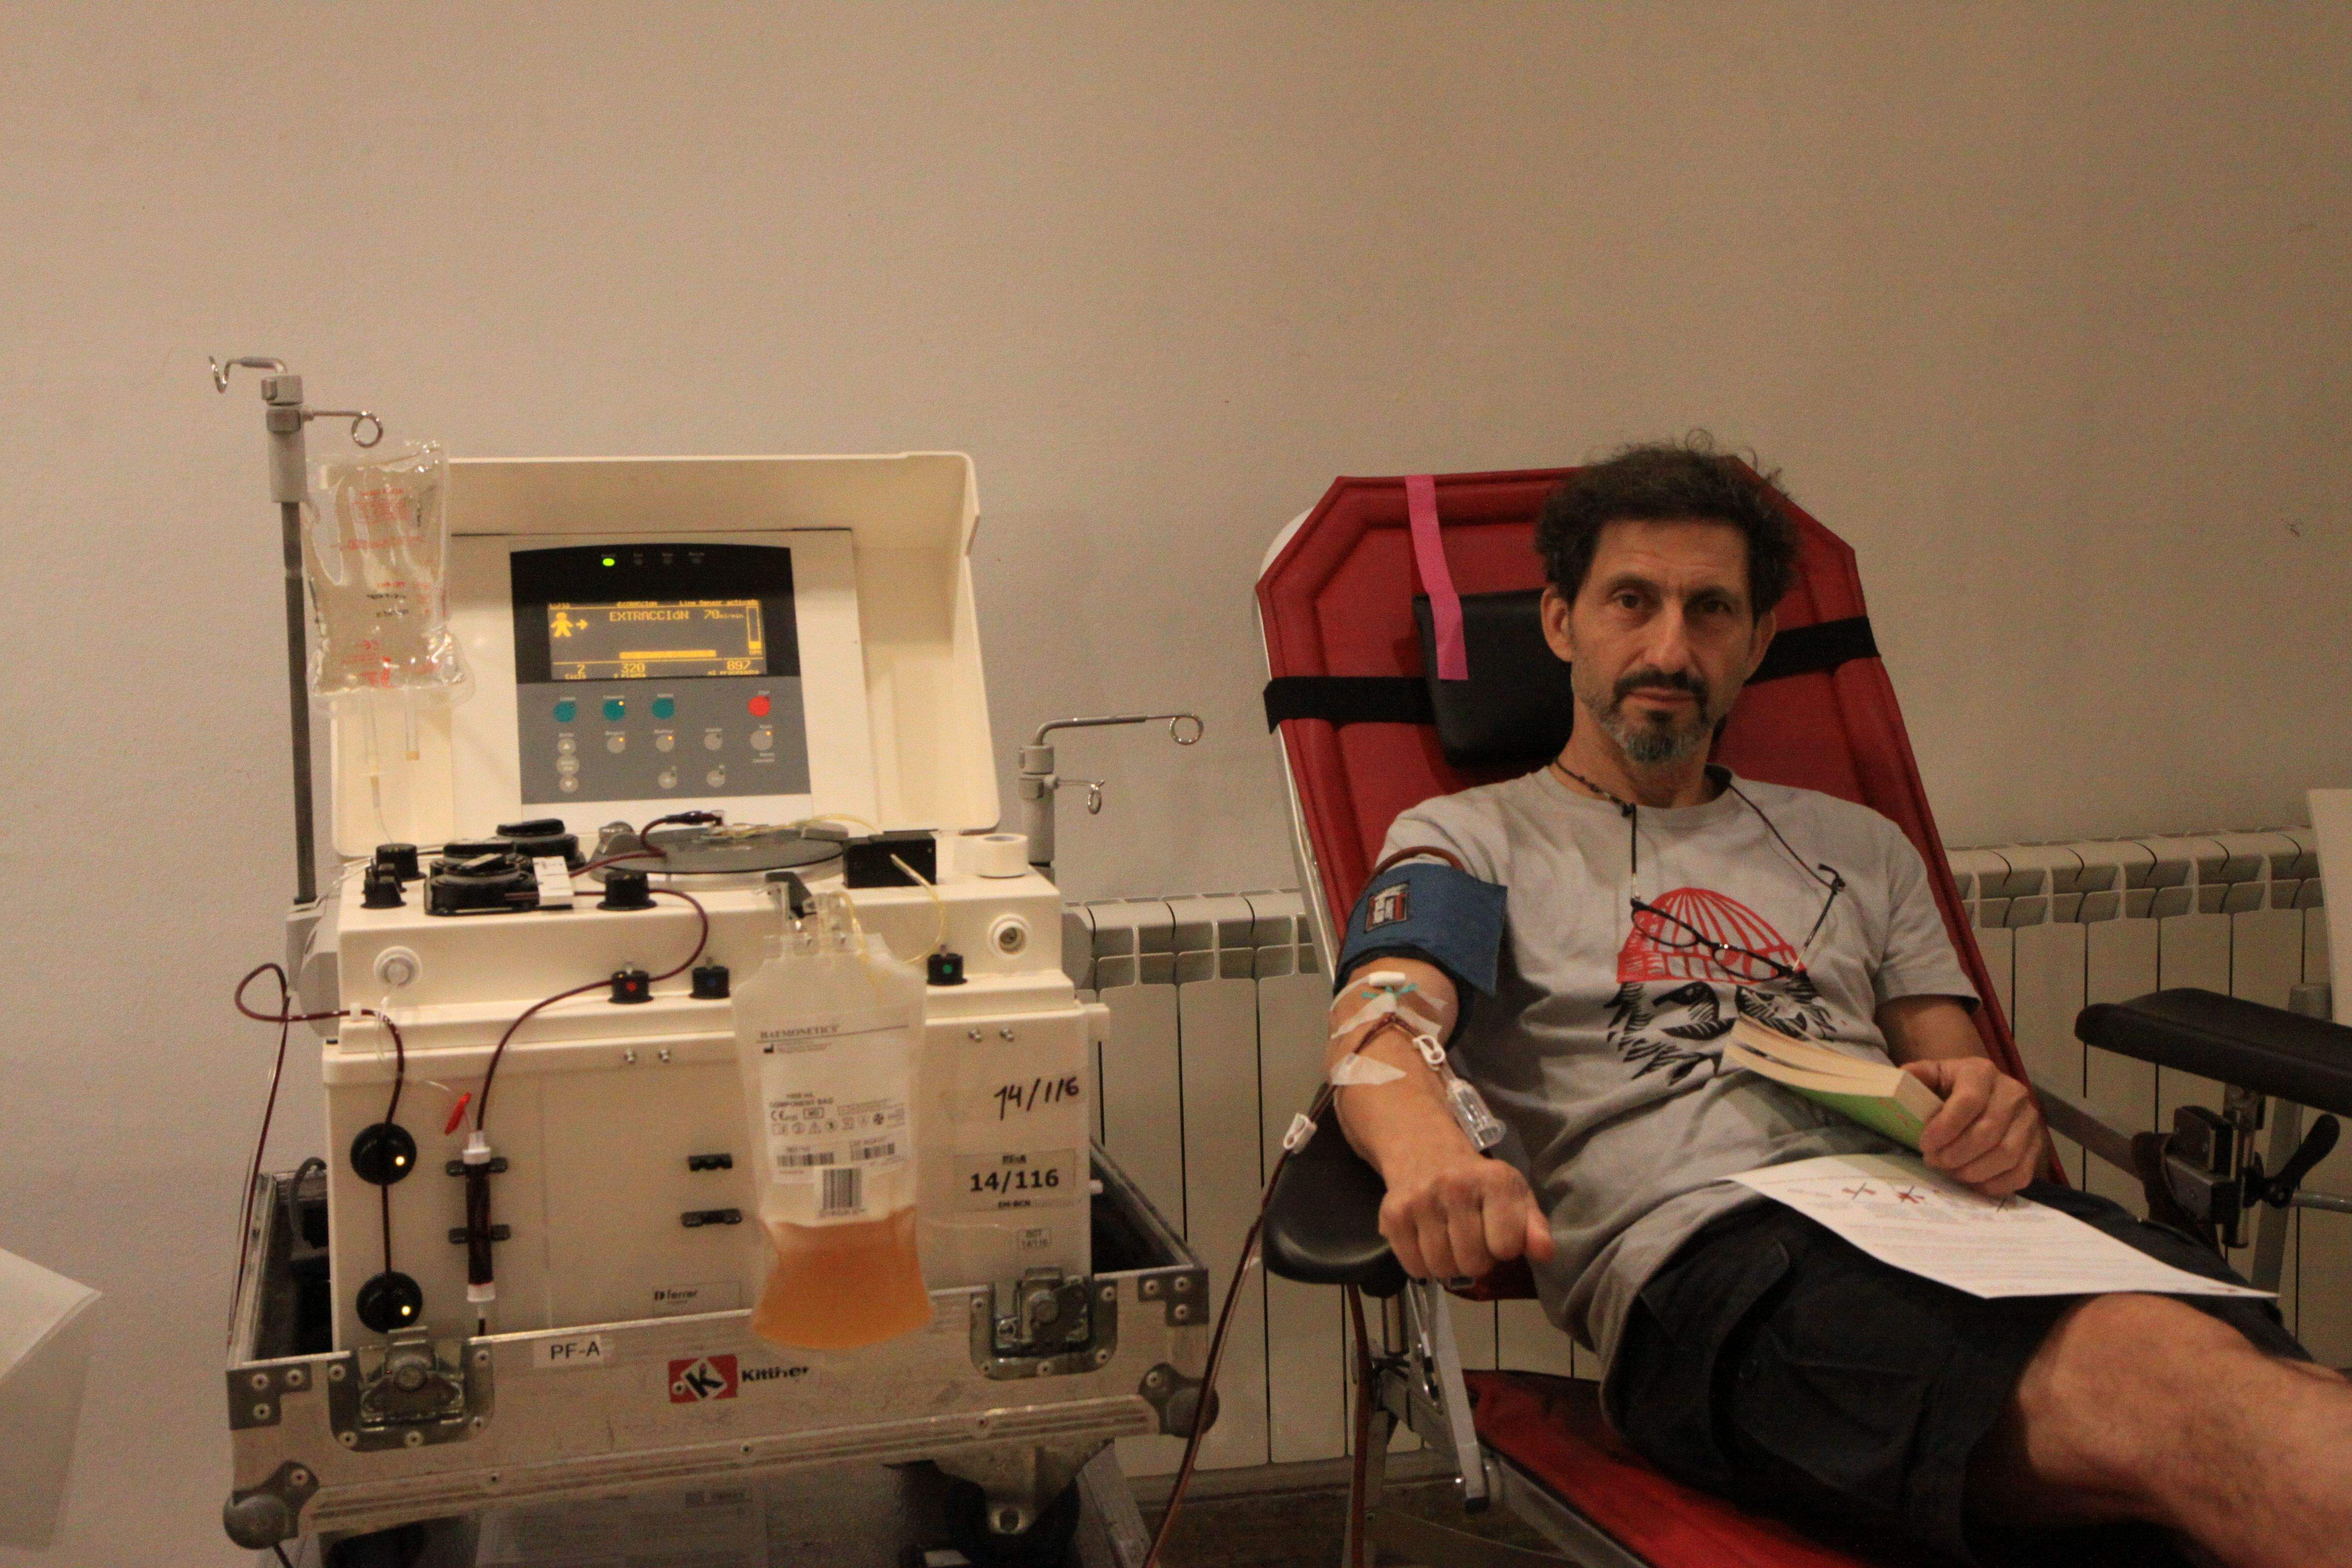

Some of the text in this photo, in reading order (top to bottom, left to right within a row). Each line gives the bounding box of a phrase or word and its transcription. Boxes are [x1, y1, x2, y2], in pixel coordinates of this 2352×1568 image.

[577, 660, 751, 675] 2 320 897
[994, 1076, 1079, 1121] 14/116
[971, 1168, 1059, 1194] 14/116
[551, 1341, 599, 1360] PF-A
